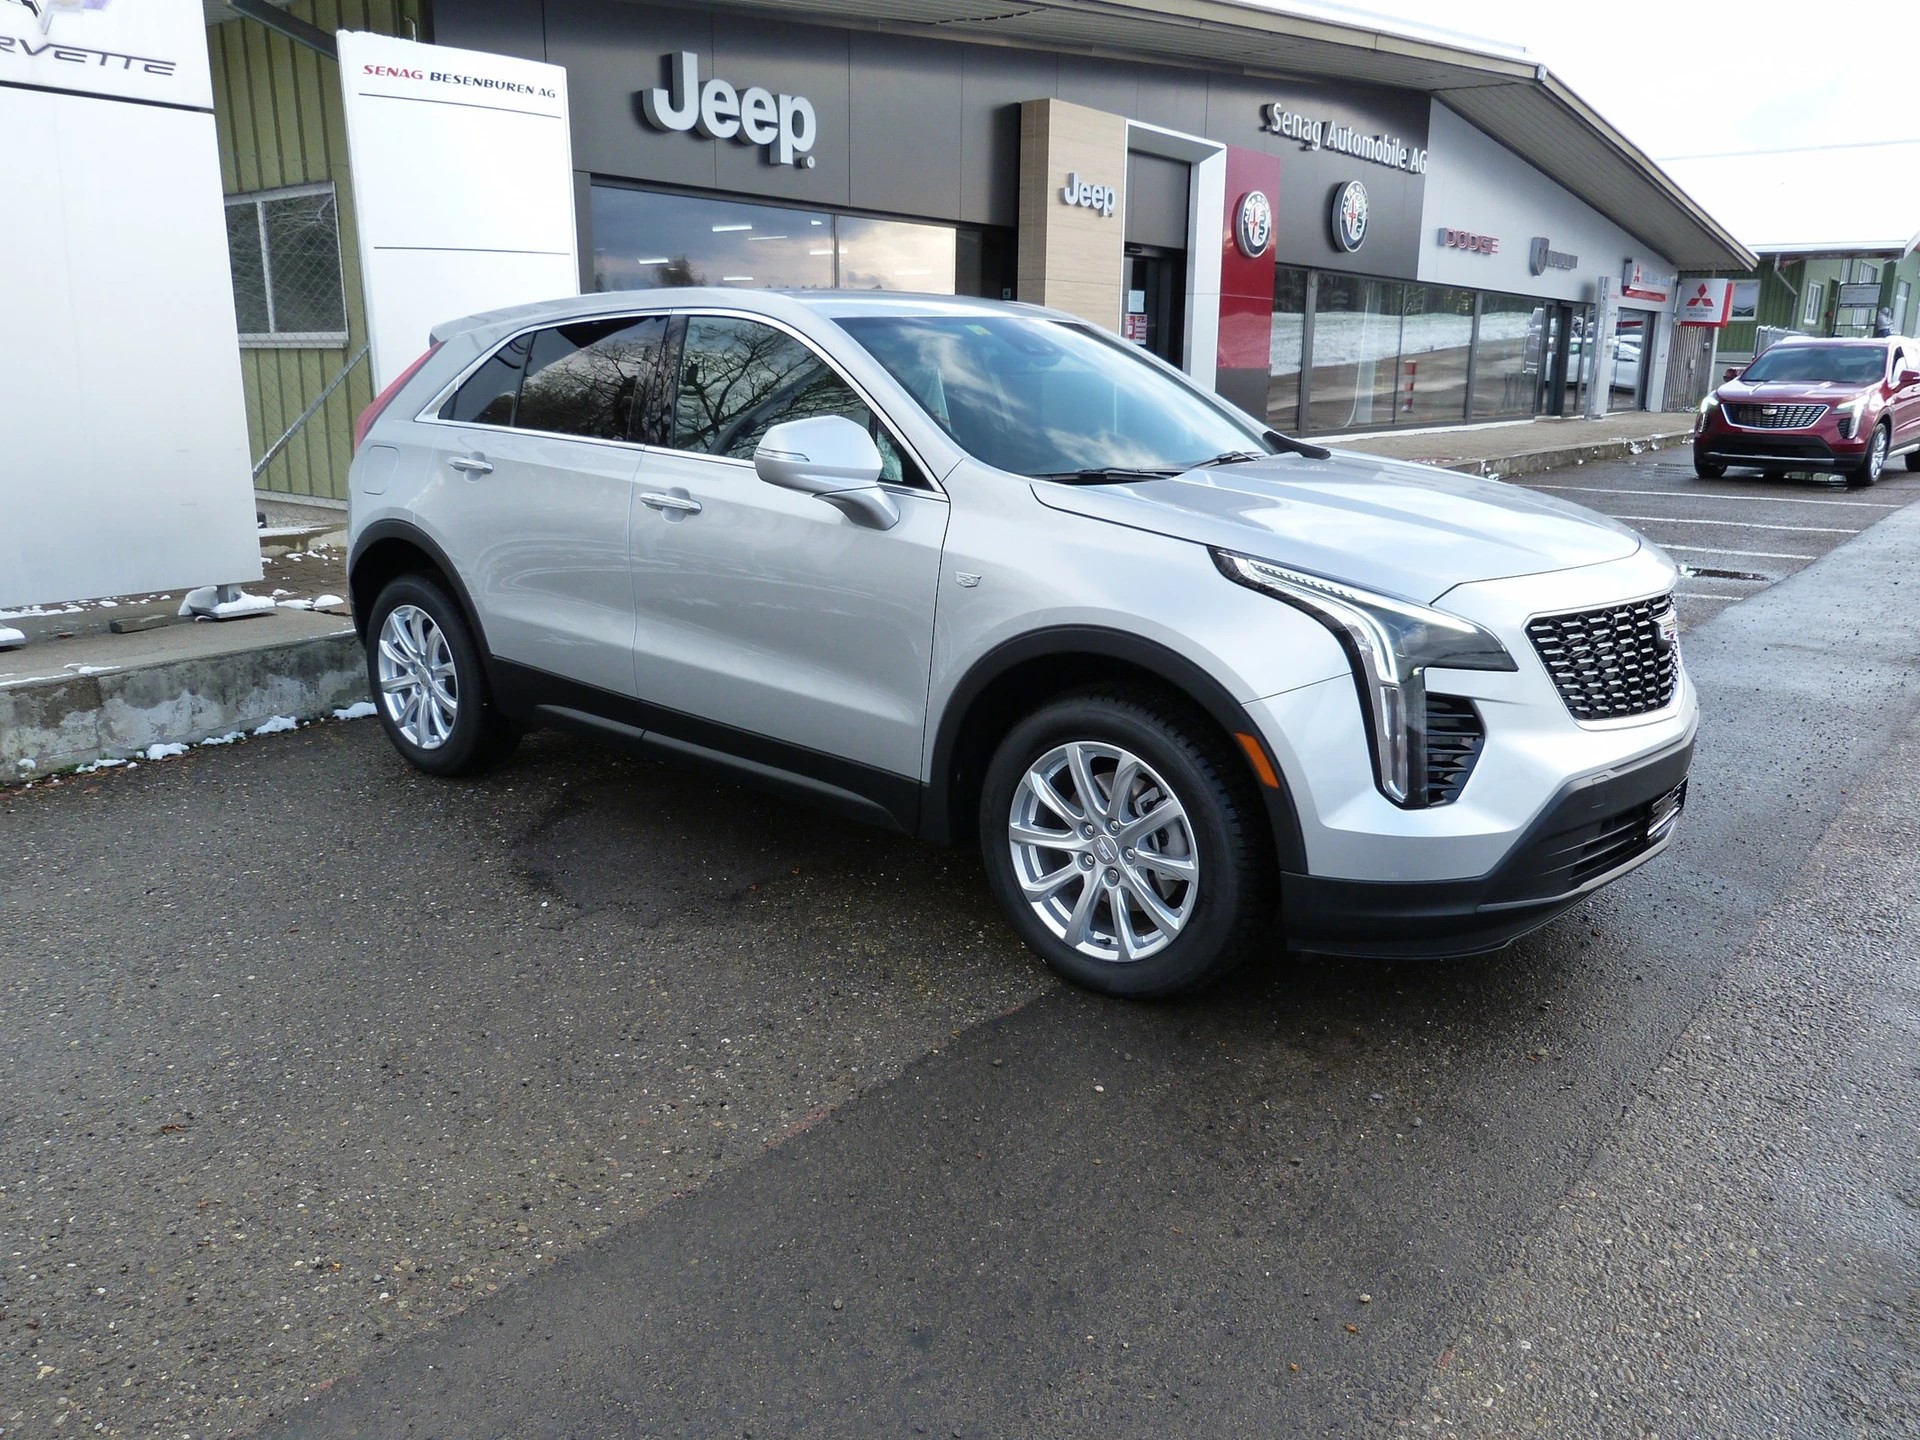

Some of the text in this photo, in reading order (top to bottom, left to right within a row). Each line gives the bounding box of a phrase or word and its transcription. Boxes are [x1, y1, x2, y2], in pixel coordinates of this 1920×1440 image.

[363, 64, 424, 80] SENAG
[538, 87, 556, 99] AG
[1272, 102, 1427, 174] Senag Automobile AG
[1064, 172, 1116, 217] Jeep
[1444, 228, 1500, 254] DODGE
